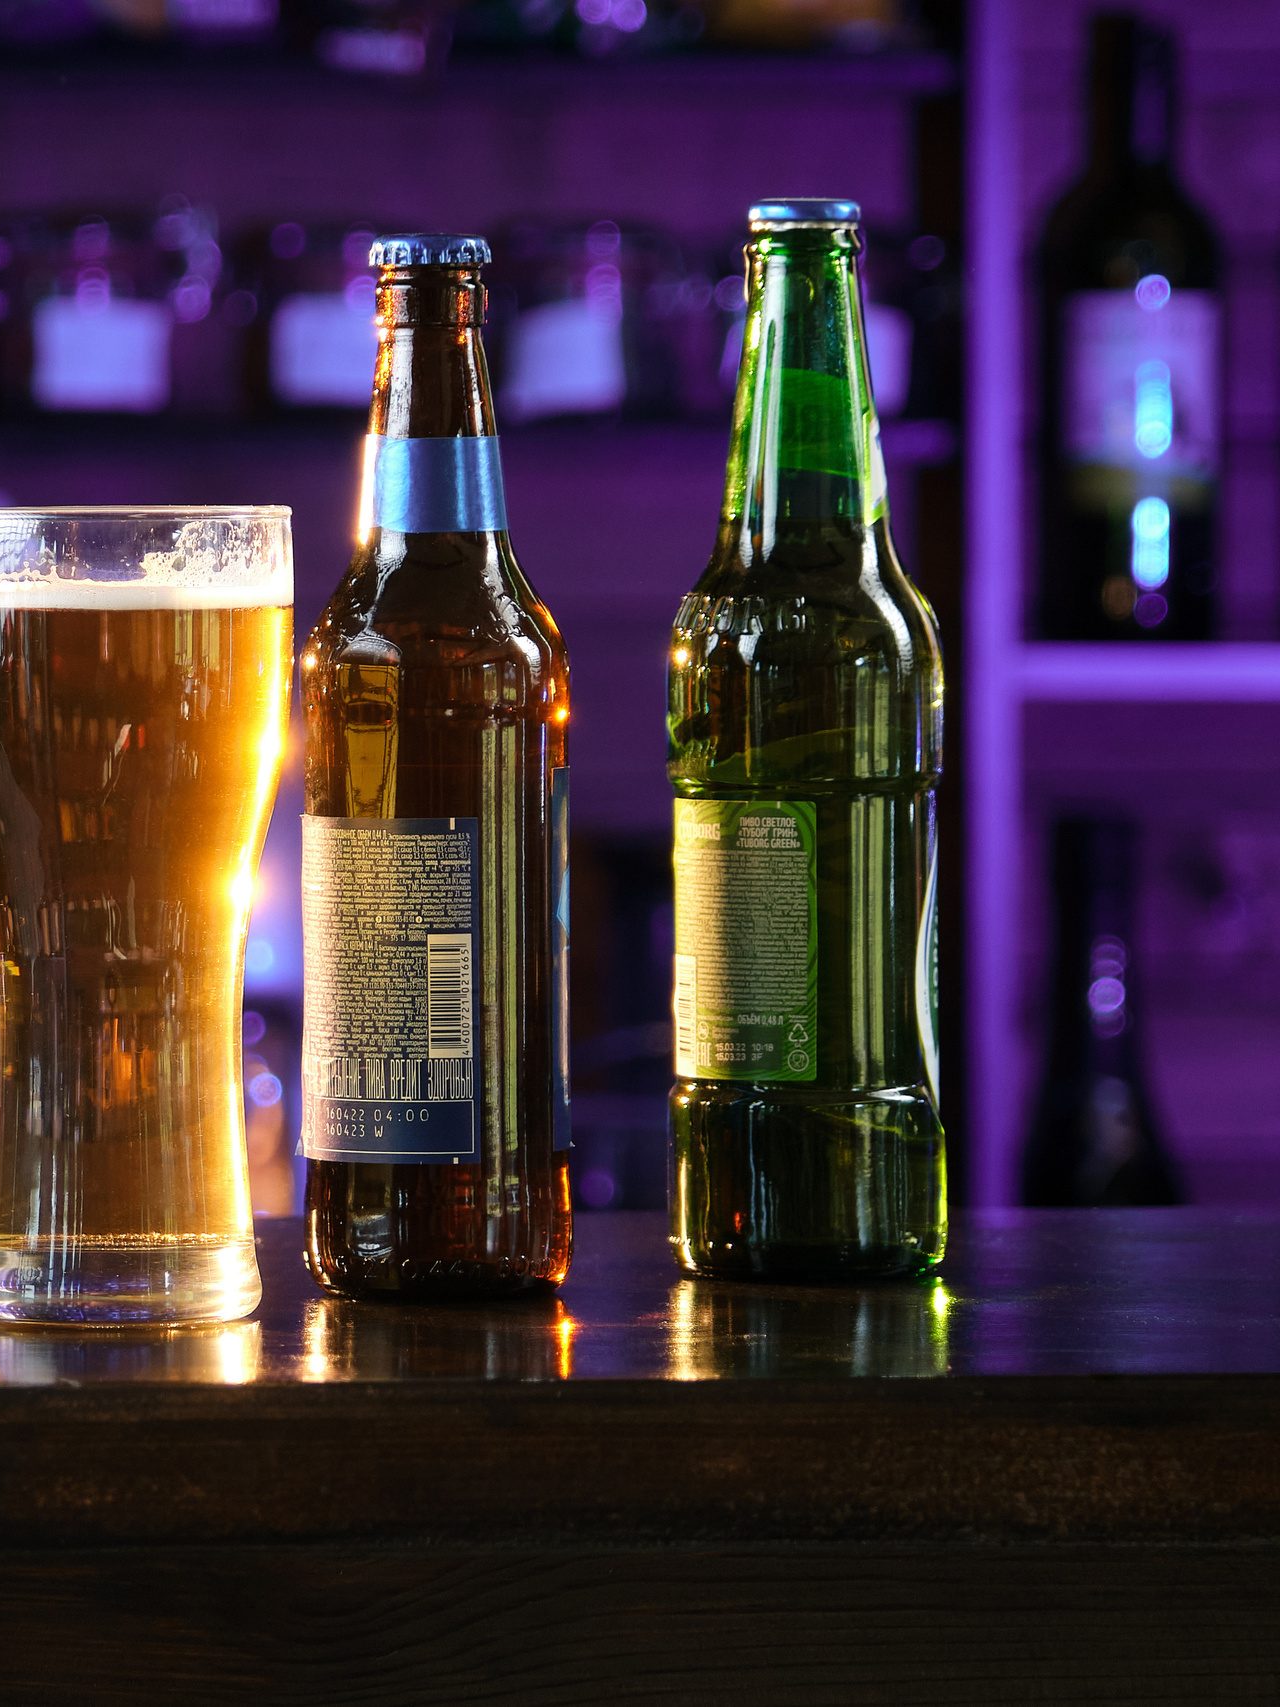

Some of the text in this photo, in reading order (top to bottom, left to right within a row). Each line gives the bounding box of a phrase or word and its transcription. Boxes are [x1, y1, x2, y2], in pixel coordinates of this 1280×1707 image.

[673, 594, 807, 633] UBORG
[739, 817, 796, 827] ПИВО СВЕТЛОЕ
[738, 827, 798, 838] «ТУБОРГ ГРИН»
[736, 838, 801, 848] «TUBORG GREEN»
[461, 948, 470, 994] 021665
[461, 1000, 470, 1044] 600721
[366, 1059, 385, 1099] ПИВА
[390, 1059, 422, 1101] ВРЕДИТ
[428, 1059, 474, 1101] ЗДОРОВЬЮ
[326, 1108, 429, 1122] 160422 04:00
[325, 1123, 384, 1137] 160423 W
